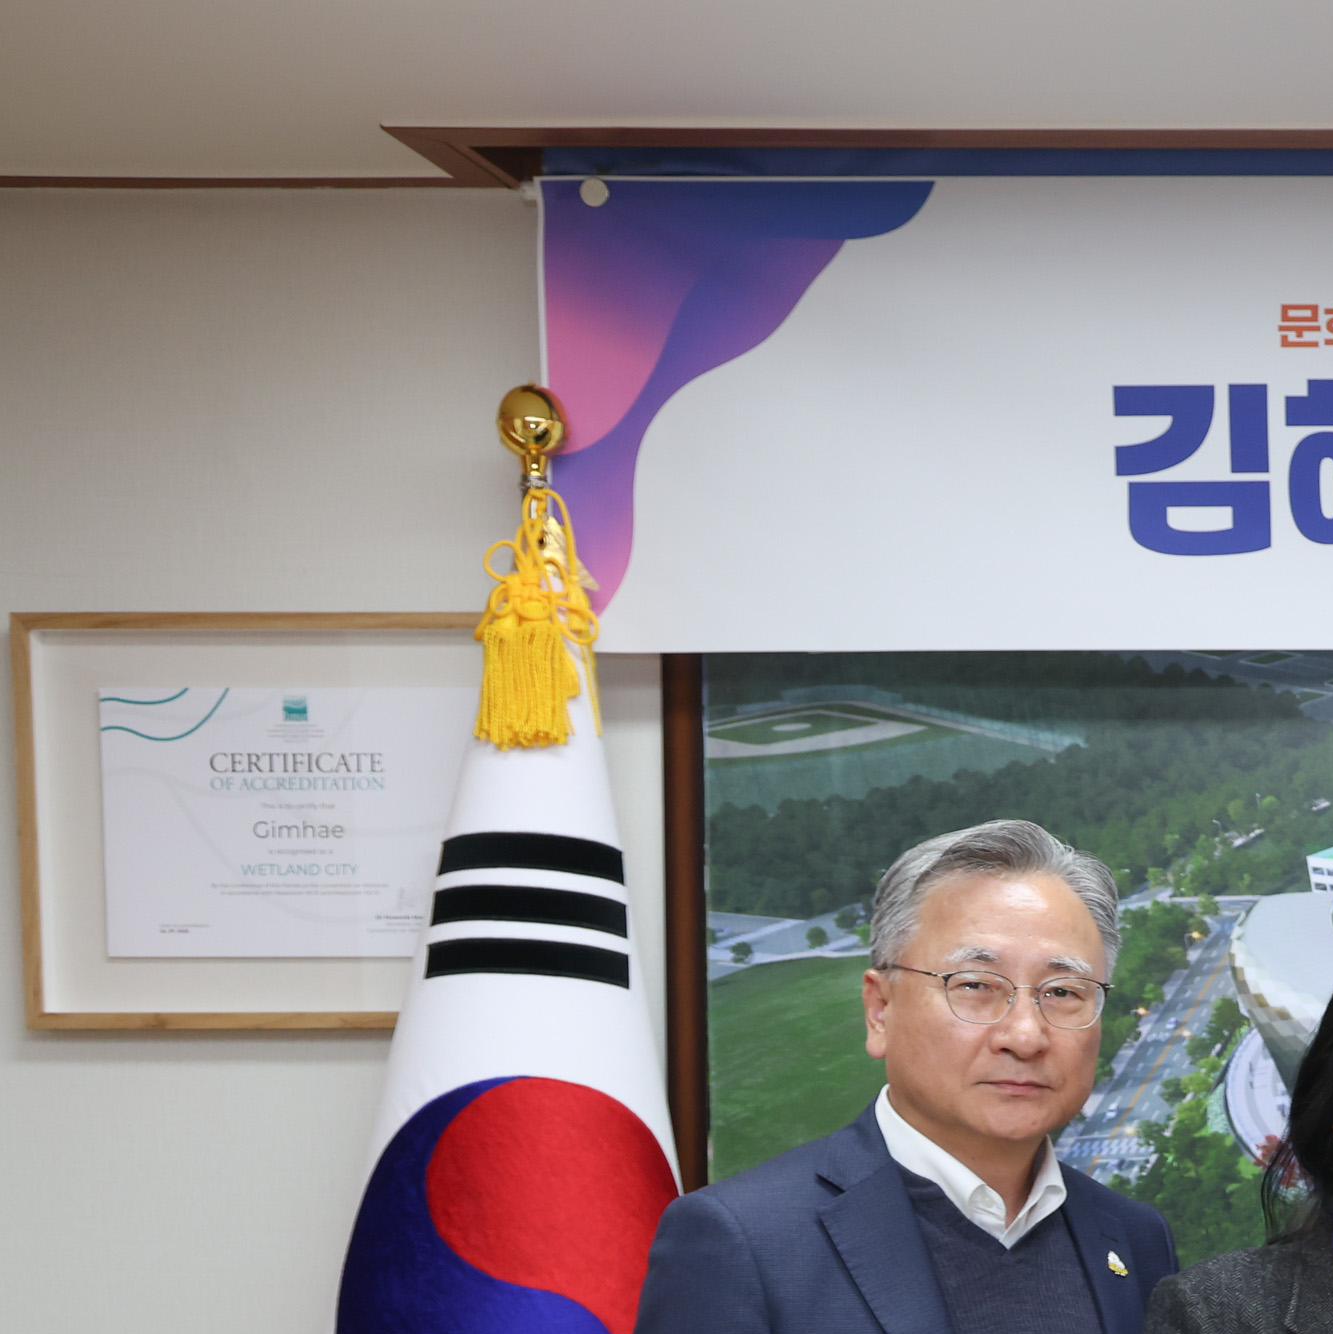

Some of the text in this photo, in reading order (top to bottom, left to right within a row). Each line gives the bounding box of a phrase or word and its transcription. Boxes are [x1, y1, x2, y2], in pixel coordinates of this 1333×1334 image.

[209, 752, 386, 774] CERTIFICATE
[209, 777, 386, 792] OF ACCREDITATION
[252, 820, 345, 839] Gimhae
[240, 864, 360, 877] WETLAND CITY
